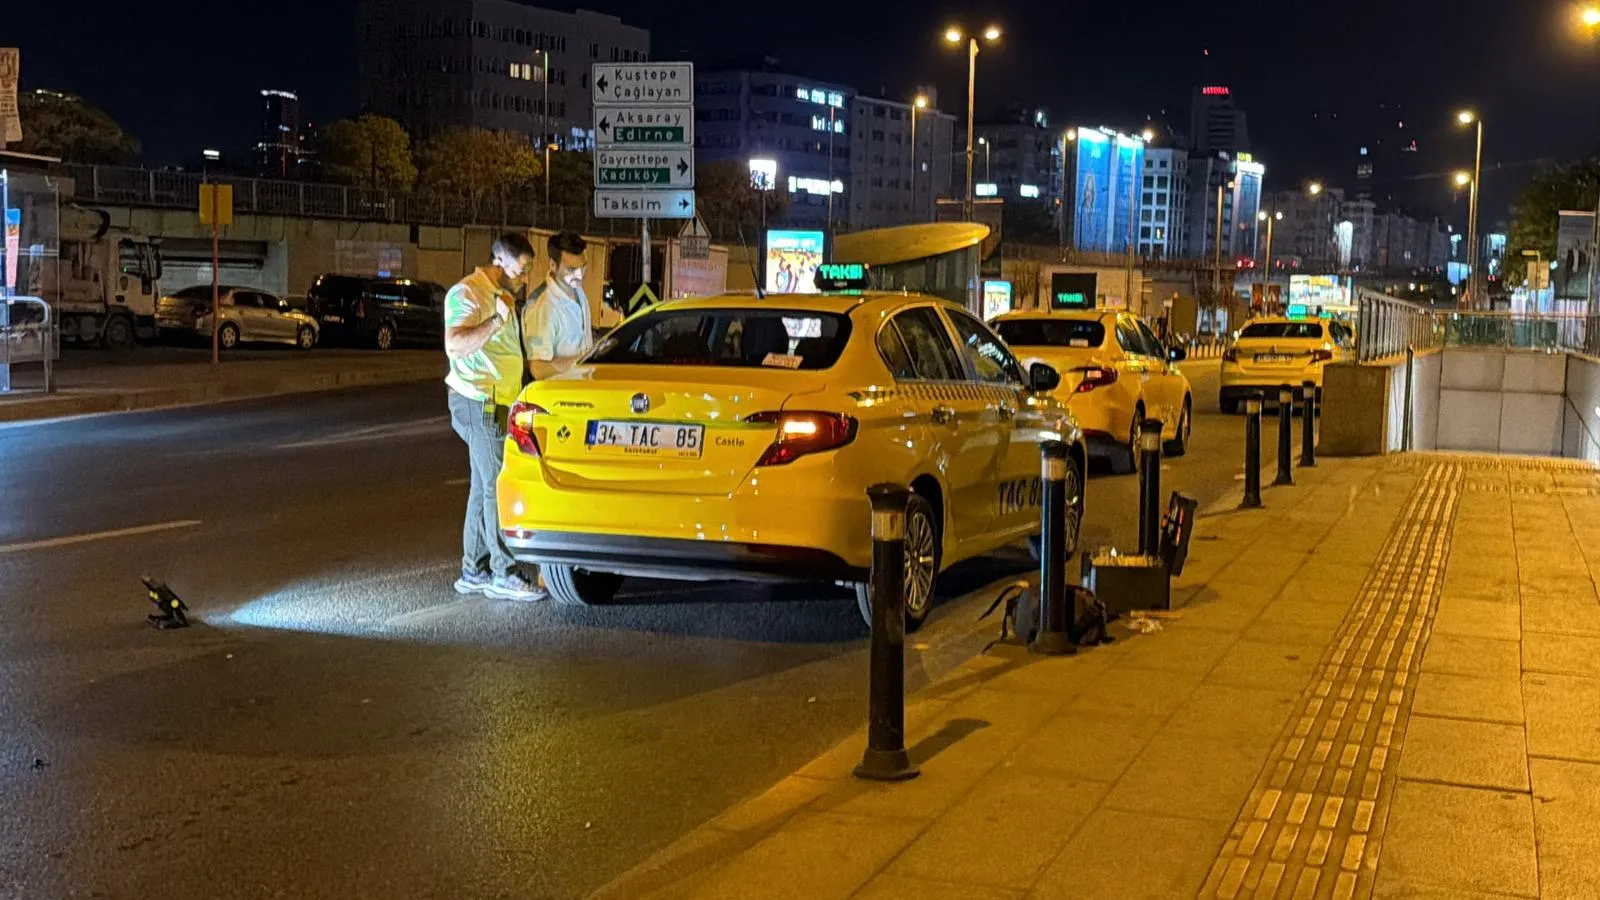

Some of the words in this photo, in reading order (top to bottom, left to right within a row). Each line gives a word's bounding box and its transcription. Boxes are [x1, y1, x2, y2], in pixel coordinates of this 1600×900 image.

[614, 69, 677, 82] Kuştepe
[614, 86, 681, 100] Çağlayan
[616, 112, 682, 125] Aksaray
[616, 128, 674, 141] Edirne
[600, 154, 669, 168] Gayrettepe
[600, 169, 659, 184] Kadıköy
[602, 197, 662, 210] Taksim
[597, 424, 617, 445] 34
[630, 425, 660, 447] TAC
[676, 427, 697, 449] 85
[998, 478, 1026, 516] TAC
